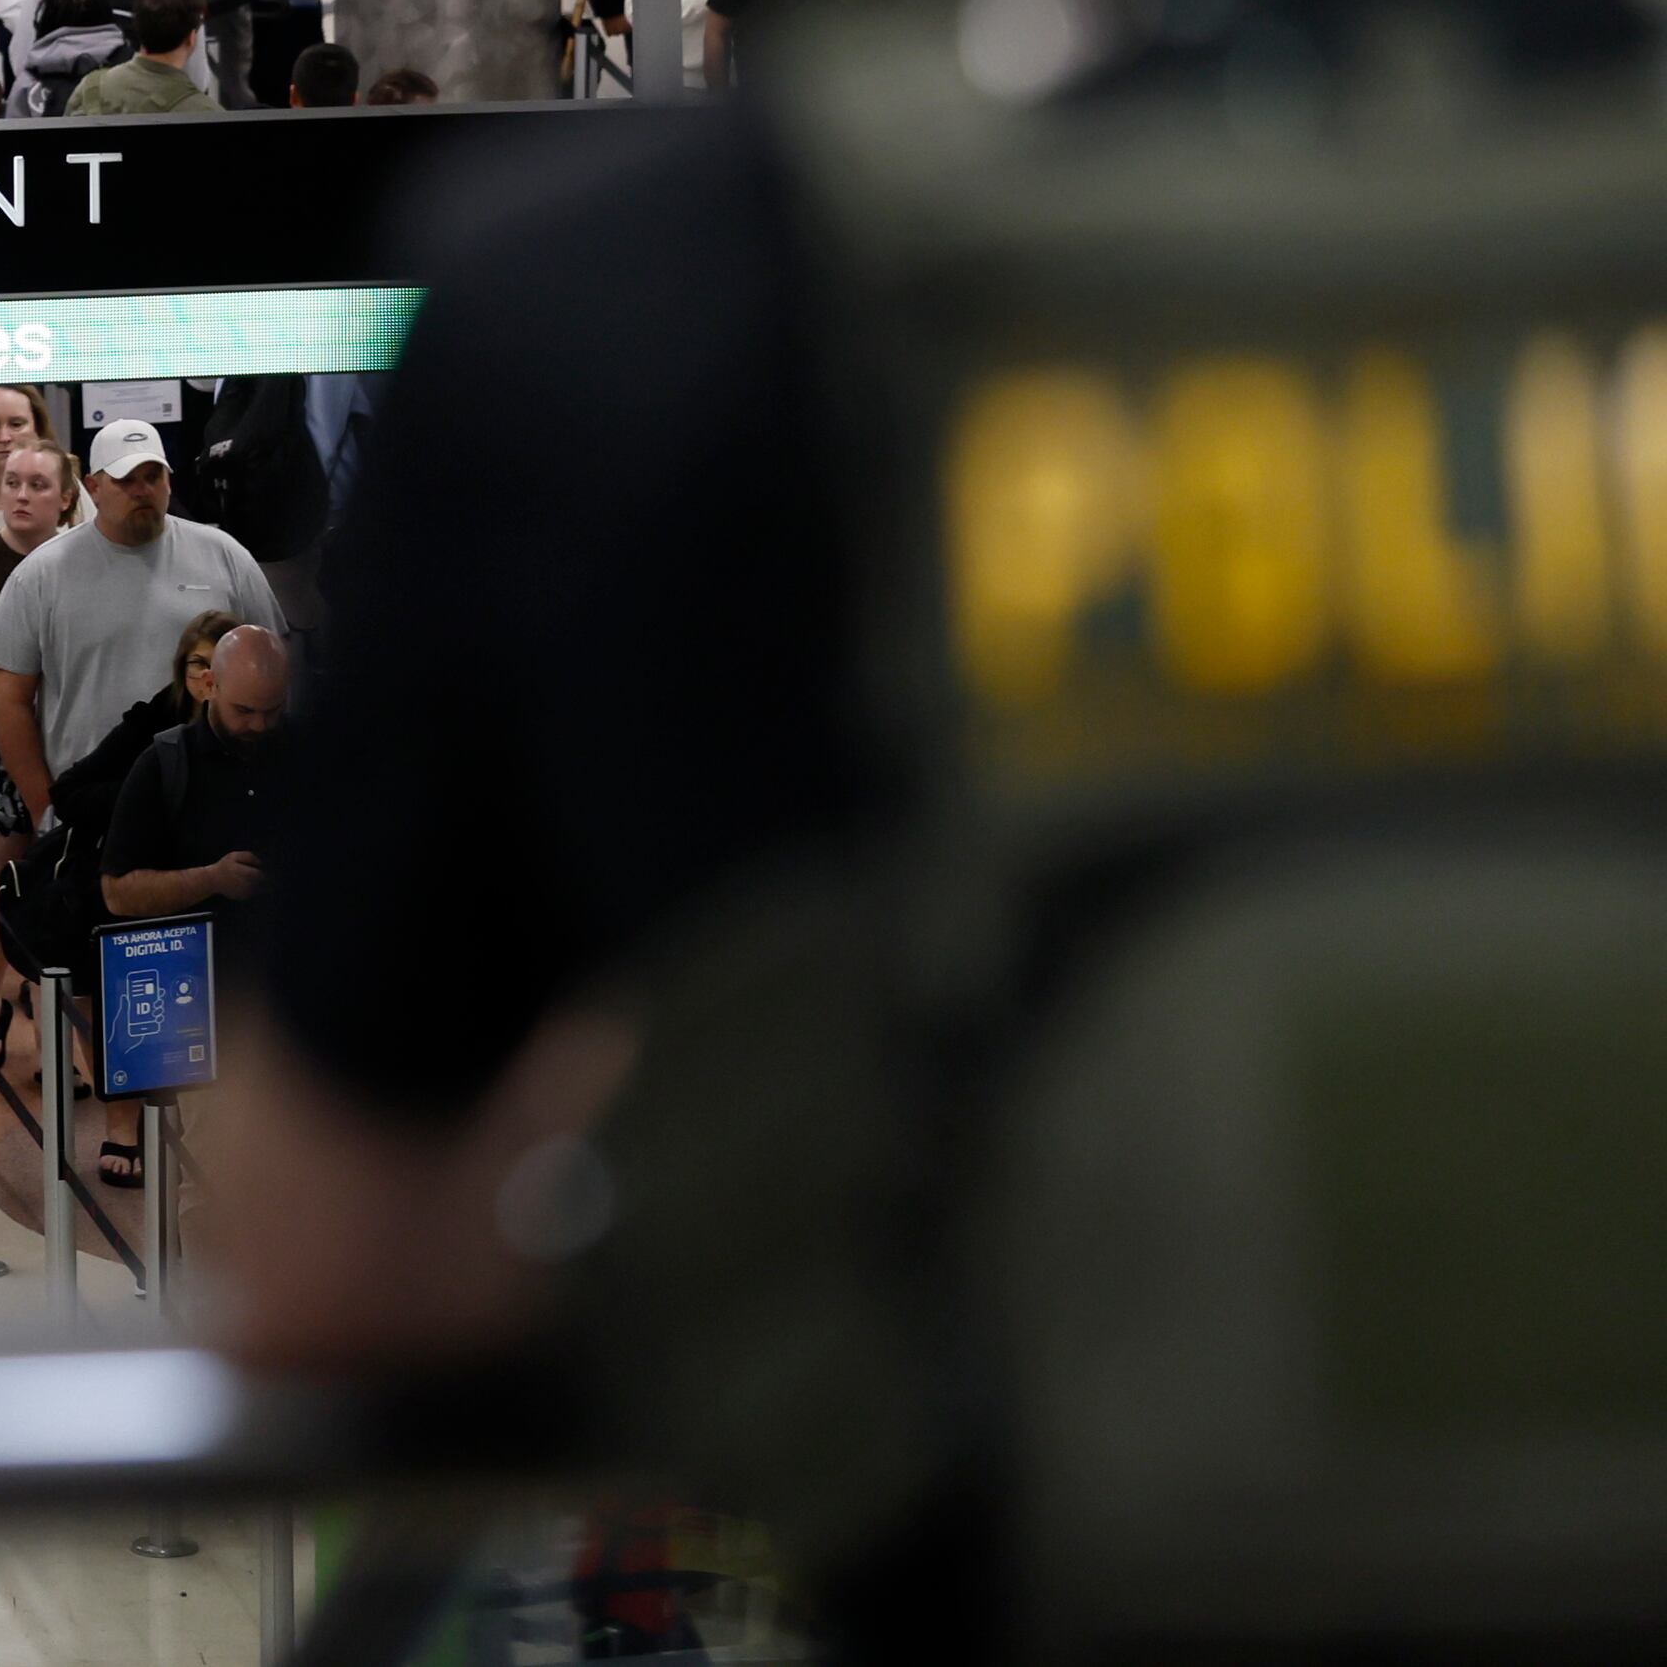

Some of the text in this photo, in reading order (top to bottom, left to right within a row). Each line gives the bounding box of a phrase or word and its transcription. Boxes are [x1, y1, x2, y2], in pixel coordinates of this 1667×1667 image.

[942, 334, 1667, 694] POLI
[112, 926, 197, 945] TSA AHORA ACEPTA
[125, 940, 185, 958] DIGITAL ID.
[136, 1002, 151, 1015] ID
